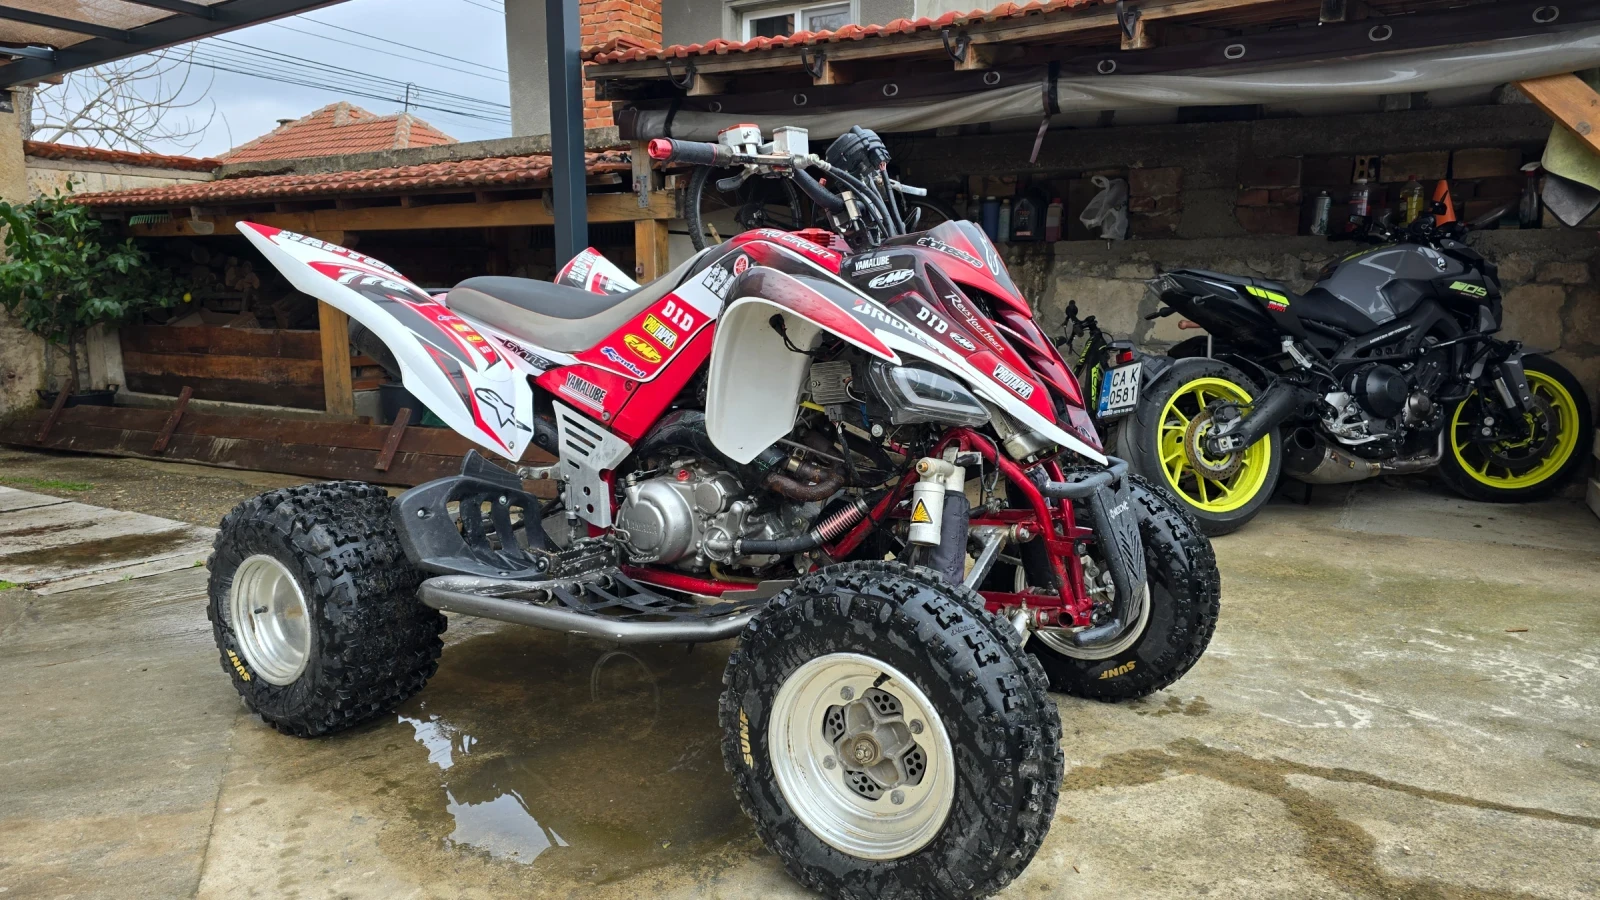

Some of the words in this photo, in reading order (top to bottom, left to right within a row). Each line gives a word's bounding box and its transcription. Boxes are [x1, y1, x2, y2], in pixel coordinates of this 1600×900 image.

[755, 229, 780, 238] PRO
[782, 233, 836, 259] CIRCUIT
[855, 255, 890, 271] YAMALUBE
[869, 269, 915, 289] FMF
[944, 290, 973, 319] Revs
[966, 316, 987, 334] Your
[984, 330, 1005, 352] Heart
[503, 339, 550, 370] GYTR
[624, 334, 662, 363] FMF
[566, 372, 607, 403] YAMALUBE
[1112, 370, 1126, 387] CA
[1130, 367, 1139, 383] K
[1109, 385, 1136, 405] 0581
